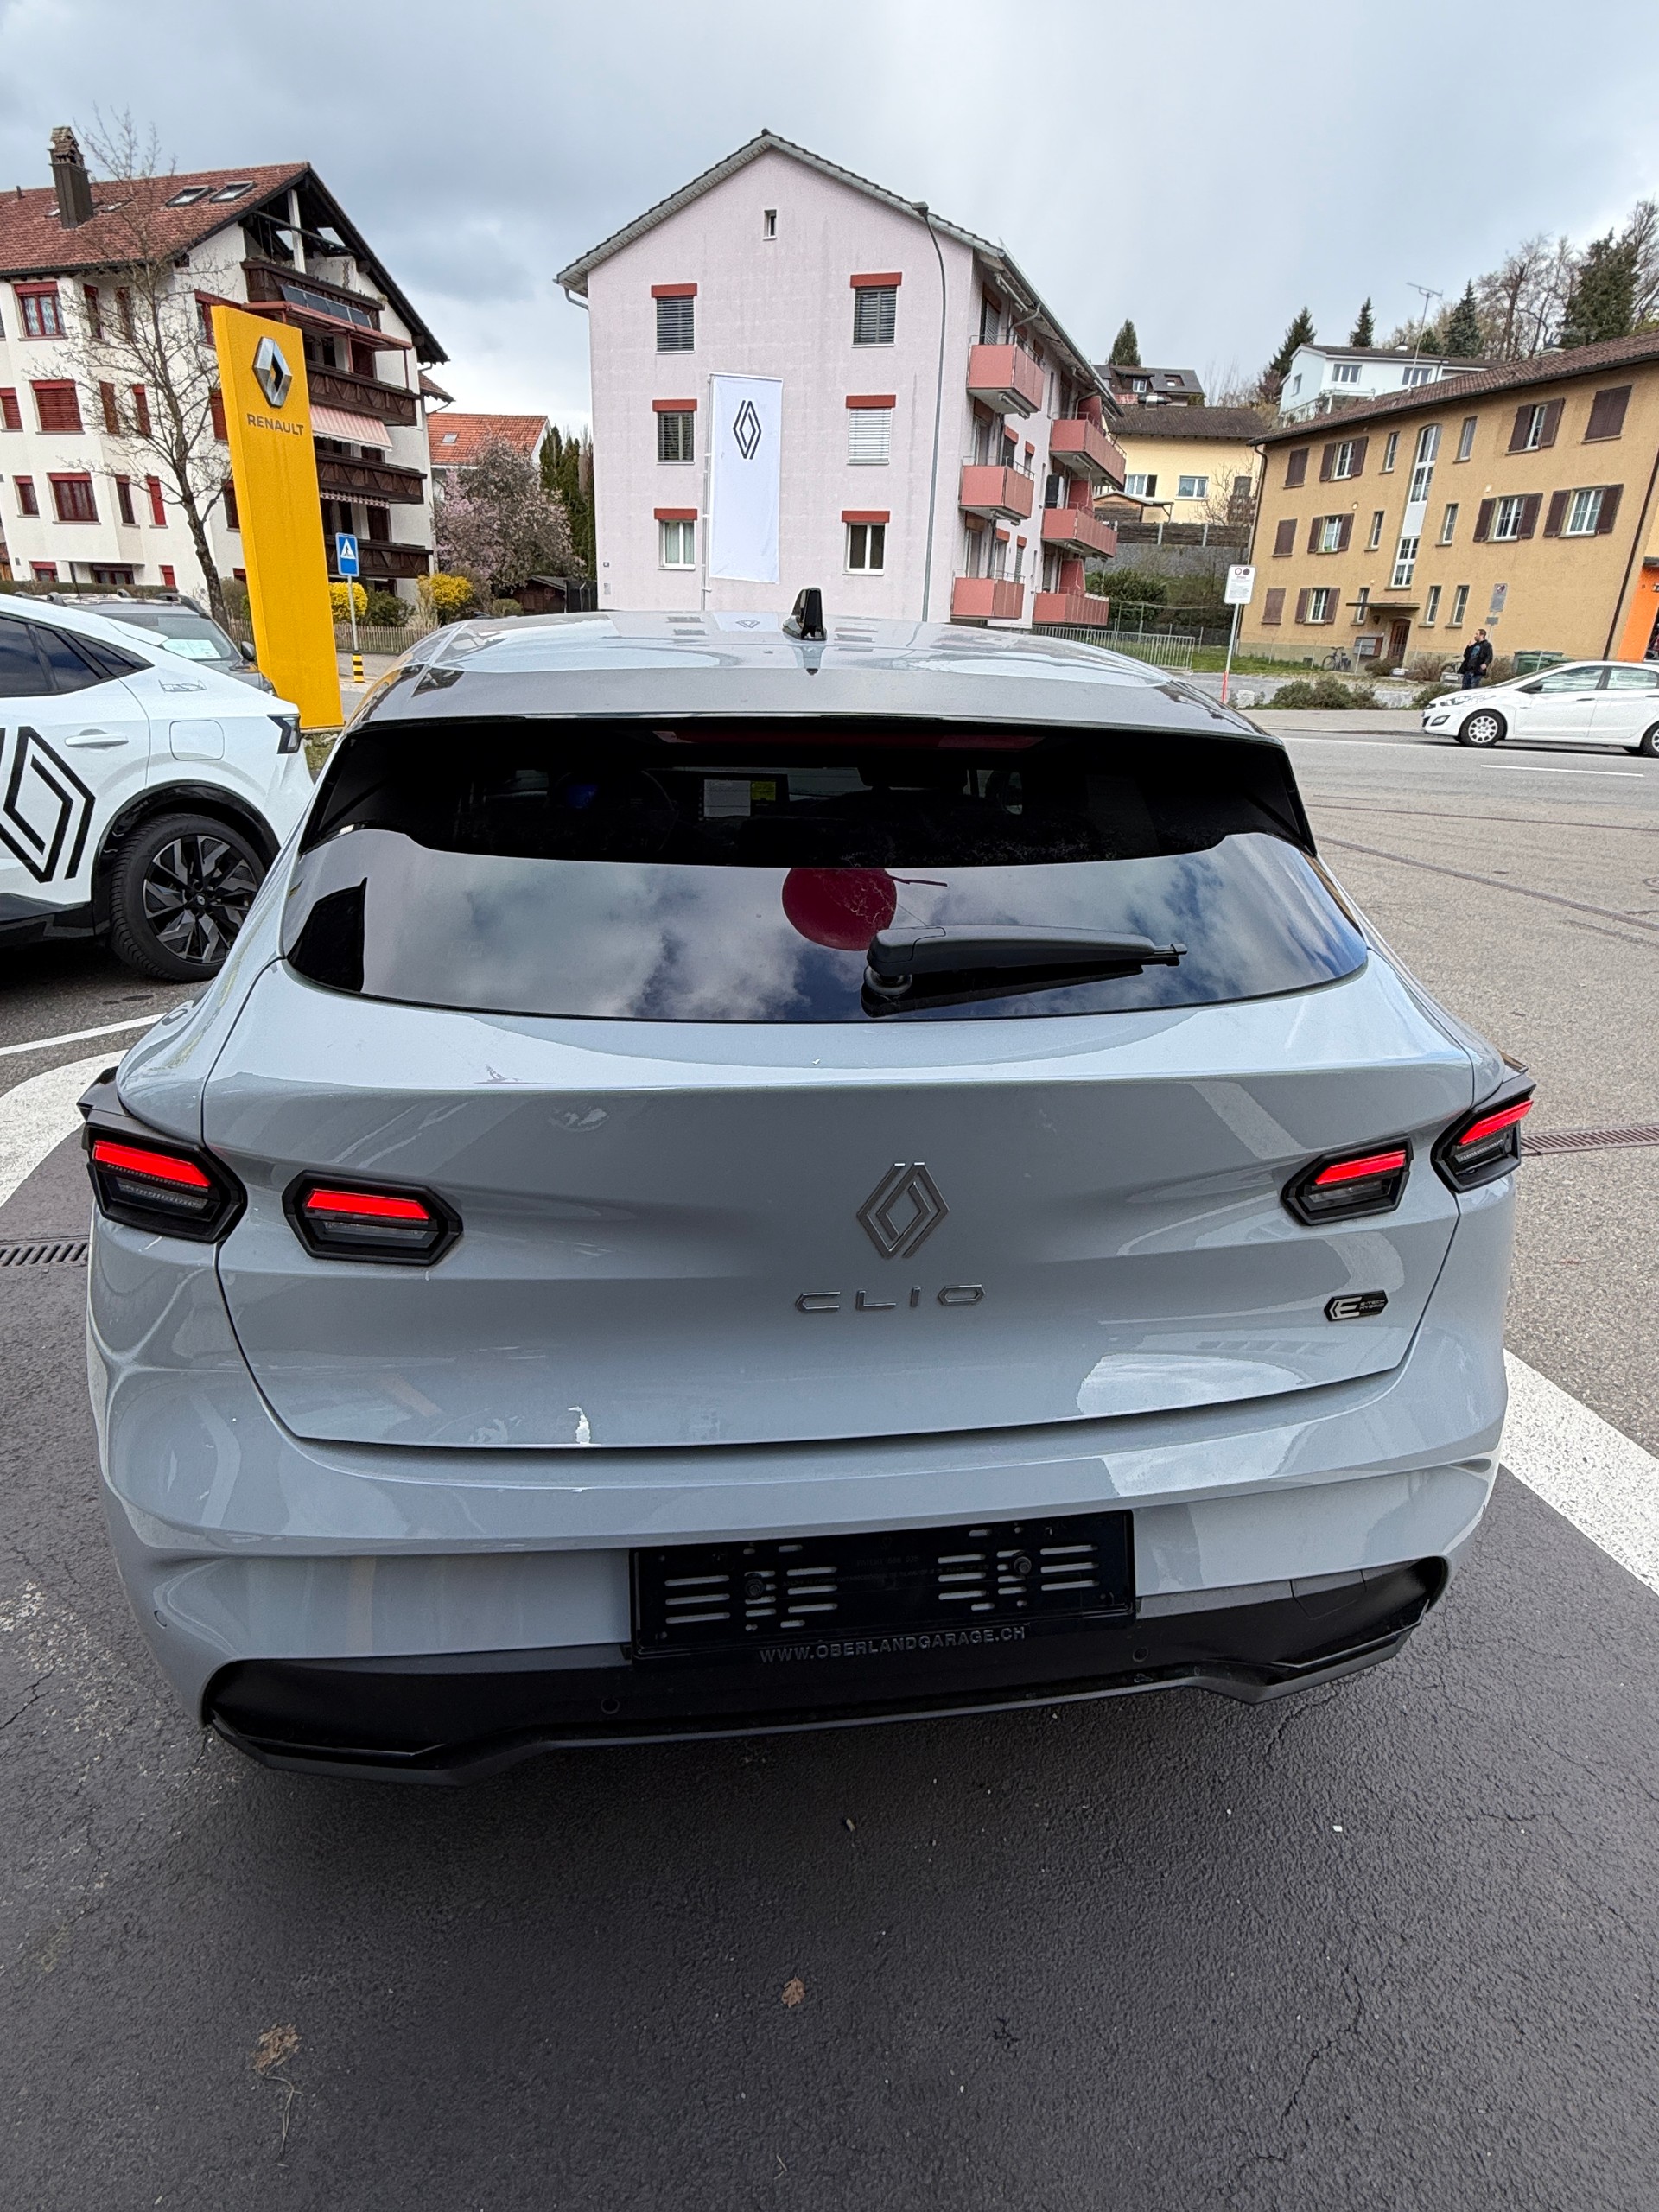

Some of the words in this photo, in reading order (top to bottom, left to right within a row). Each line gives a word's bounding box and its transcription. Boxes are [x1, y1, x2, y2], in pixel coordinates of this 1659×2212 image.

[246, 413, 304, 436] RENAULT
[795, 1284, 985, 1313] CLIO
[760, 1626, 1026, 1664] WWW.OBERLANDGARAGE.CH
